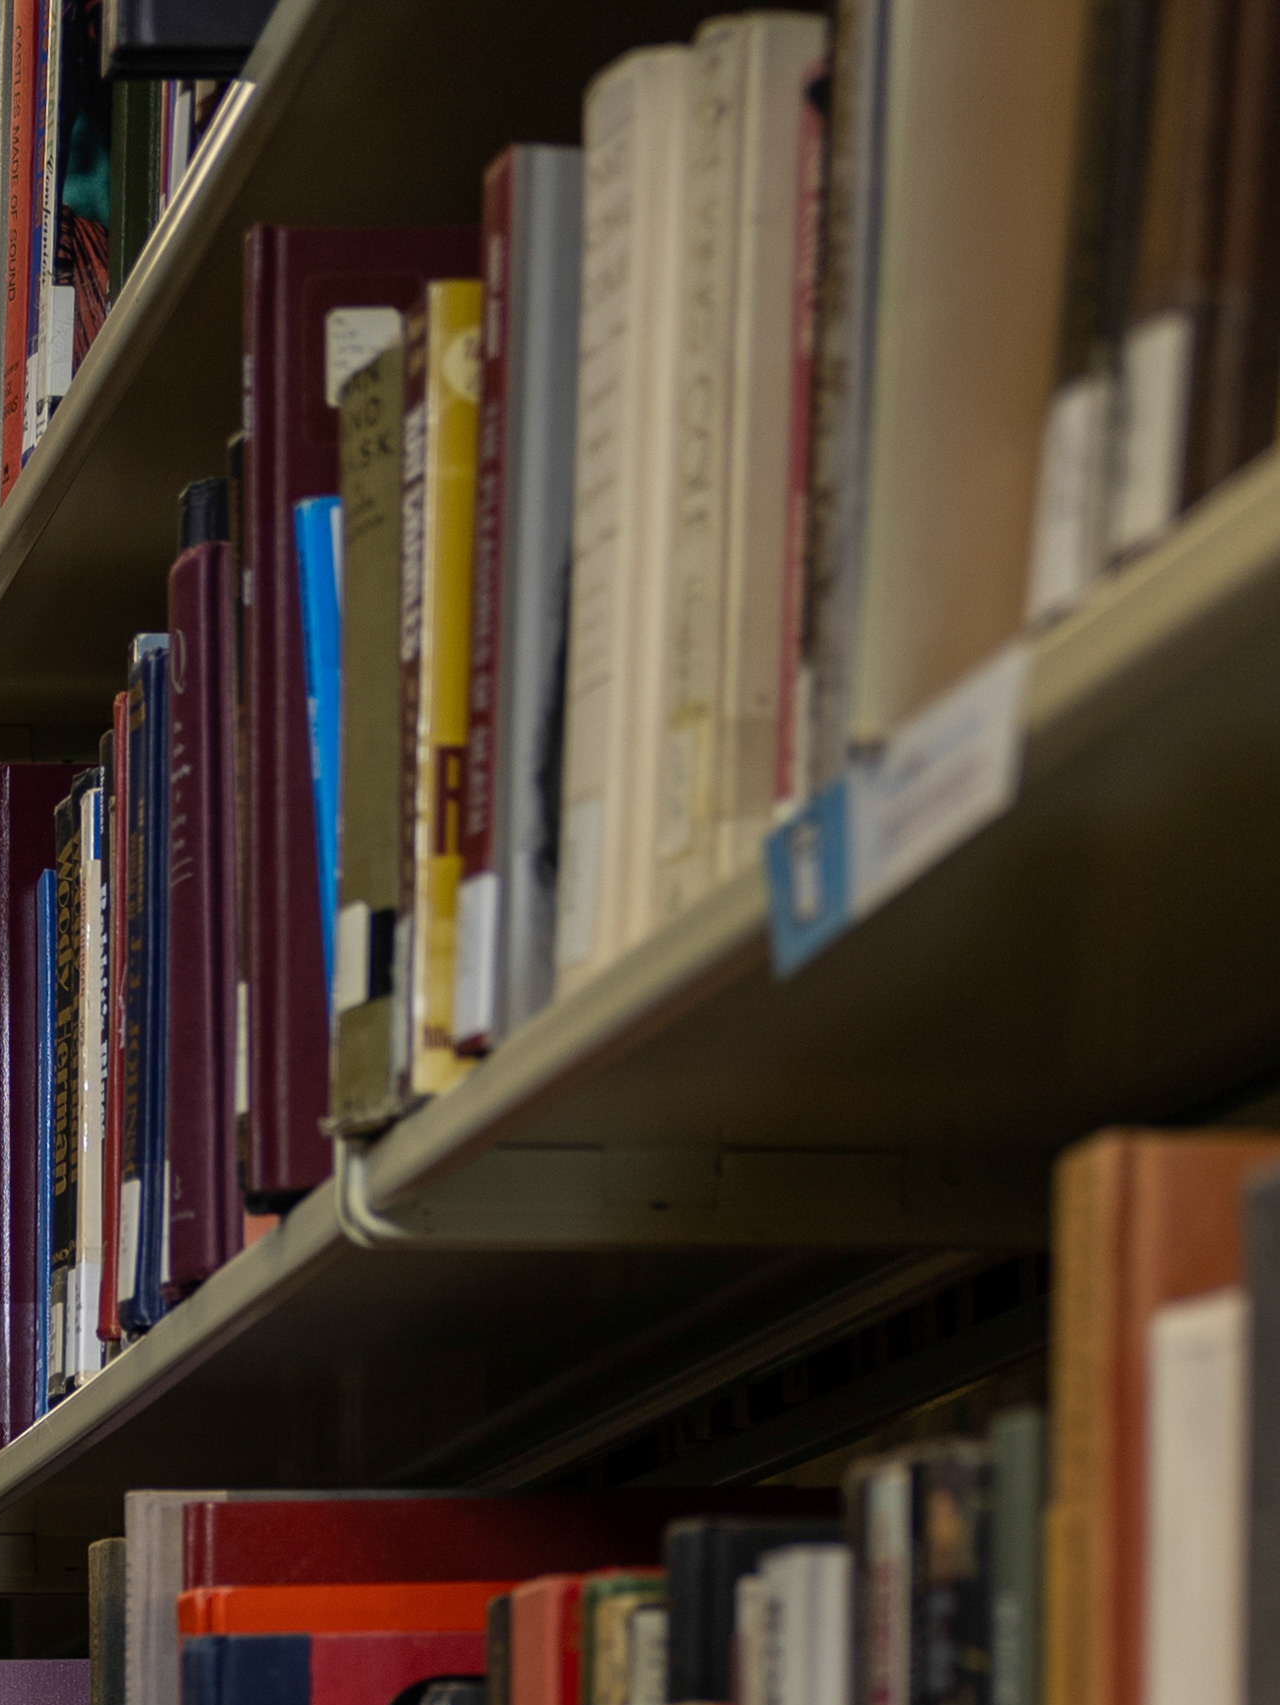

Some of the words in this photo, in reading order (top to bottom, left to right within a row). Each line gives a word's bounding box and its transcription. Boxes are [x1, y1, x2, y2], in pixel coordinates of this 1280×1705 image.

[11, 24, 23, 119] CASTLES
[10, 126, 20, 186] MADE
[9, 194, 20, 219] OF
[7, 226, 18, 302] SOUND
[56, 838, 74, 992] Woody
[54, 1019, 73, 1197] Herman
